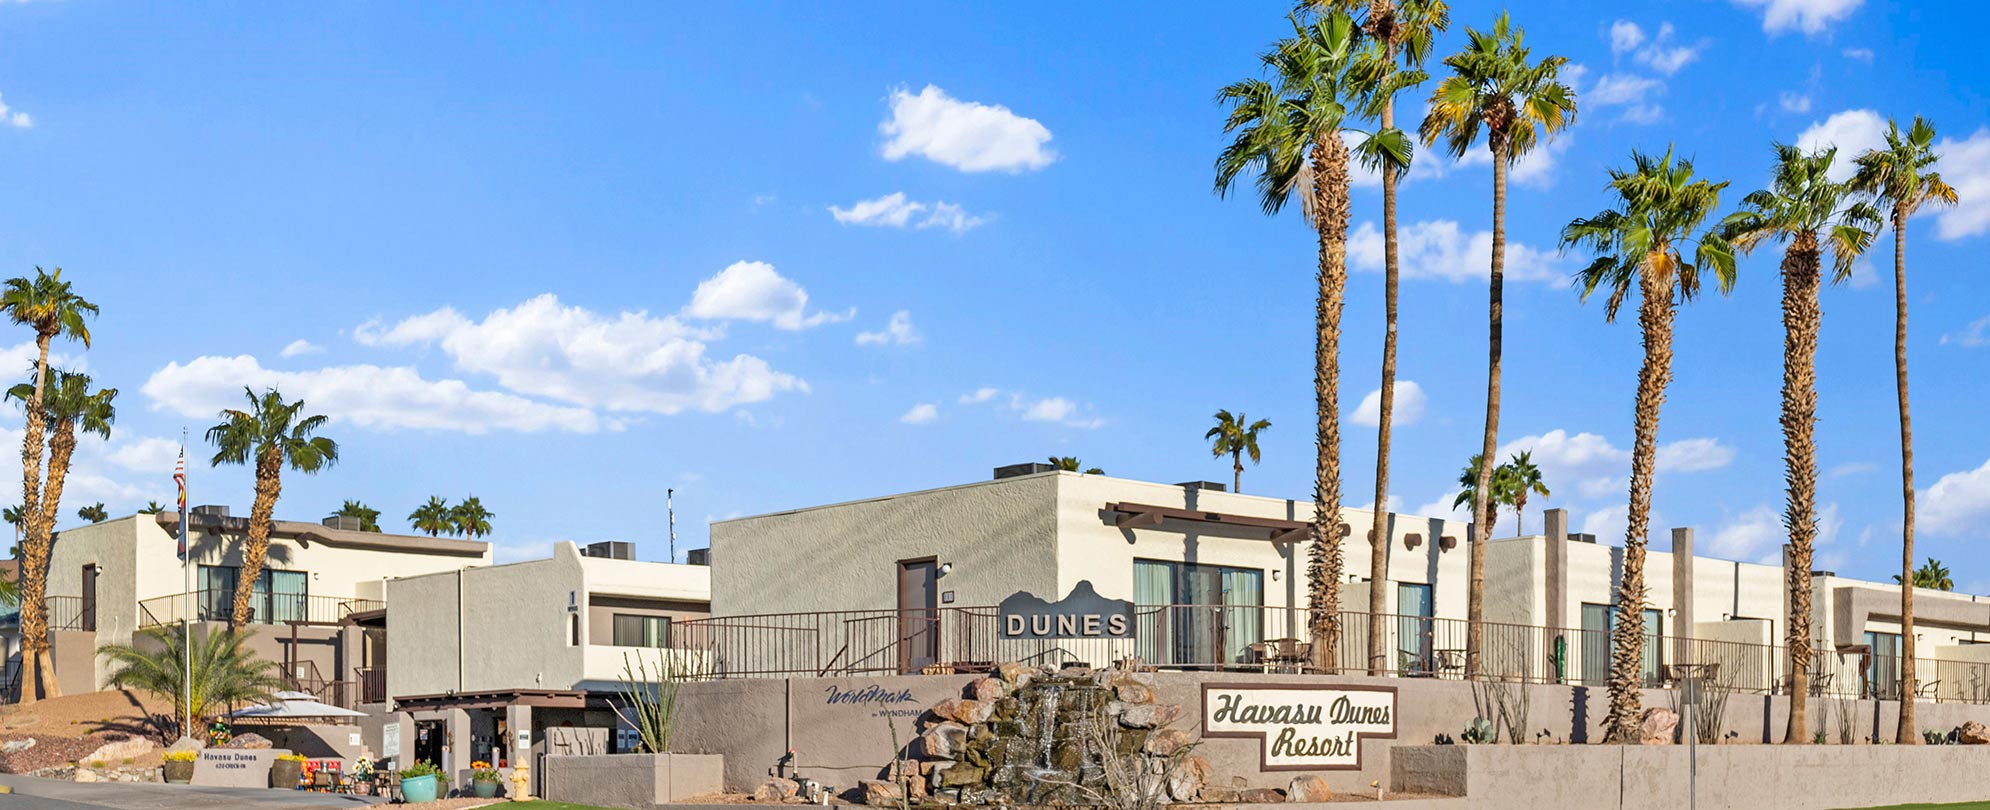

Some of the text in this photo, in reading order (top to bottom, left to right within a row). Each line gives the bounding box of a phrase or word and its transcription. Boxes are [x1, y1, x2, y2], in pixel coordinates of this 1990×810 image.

[1006, 613, 1127, 636] DUNES
[825, 684, 920, 706] WorldMark
[879, 709, 922, 717] WYNDHAM
[1213, 694, 1390, 725] Havasu Dunes
[1272, 727, 1354, 757] Resort
[204, 753, 257, 761] Havasu Dunes
